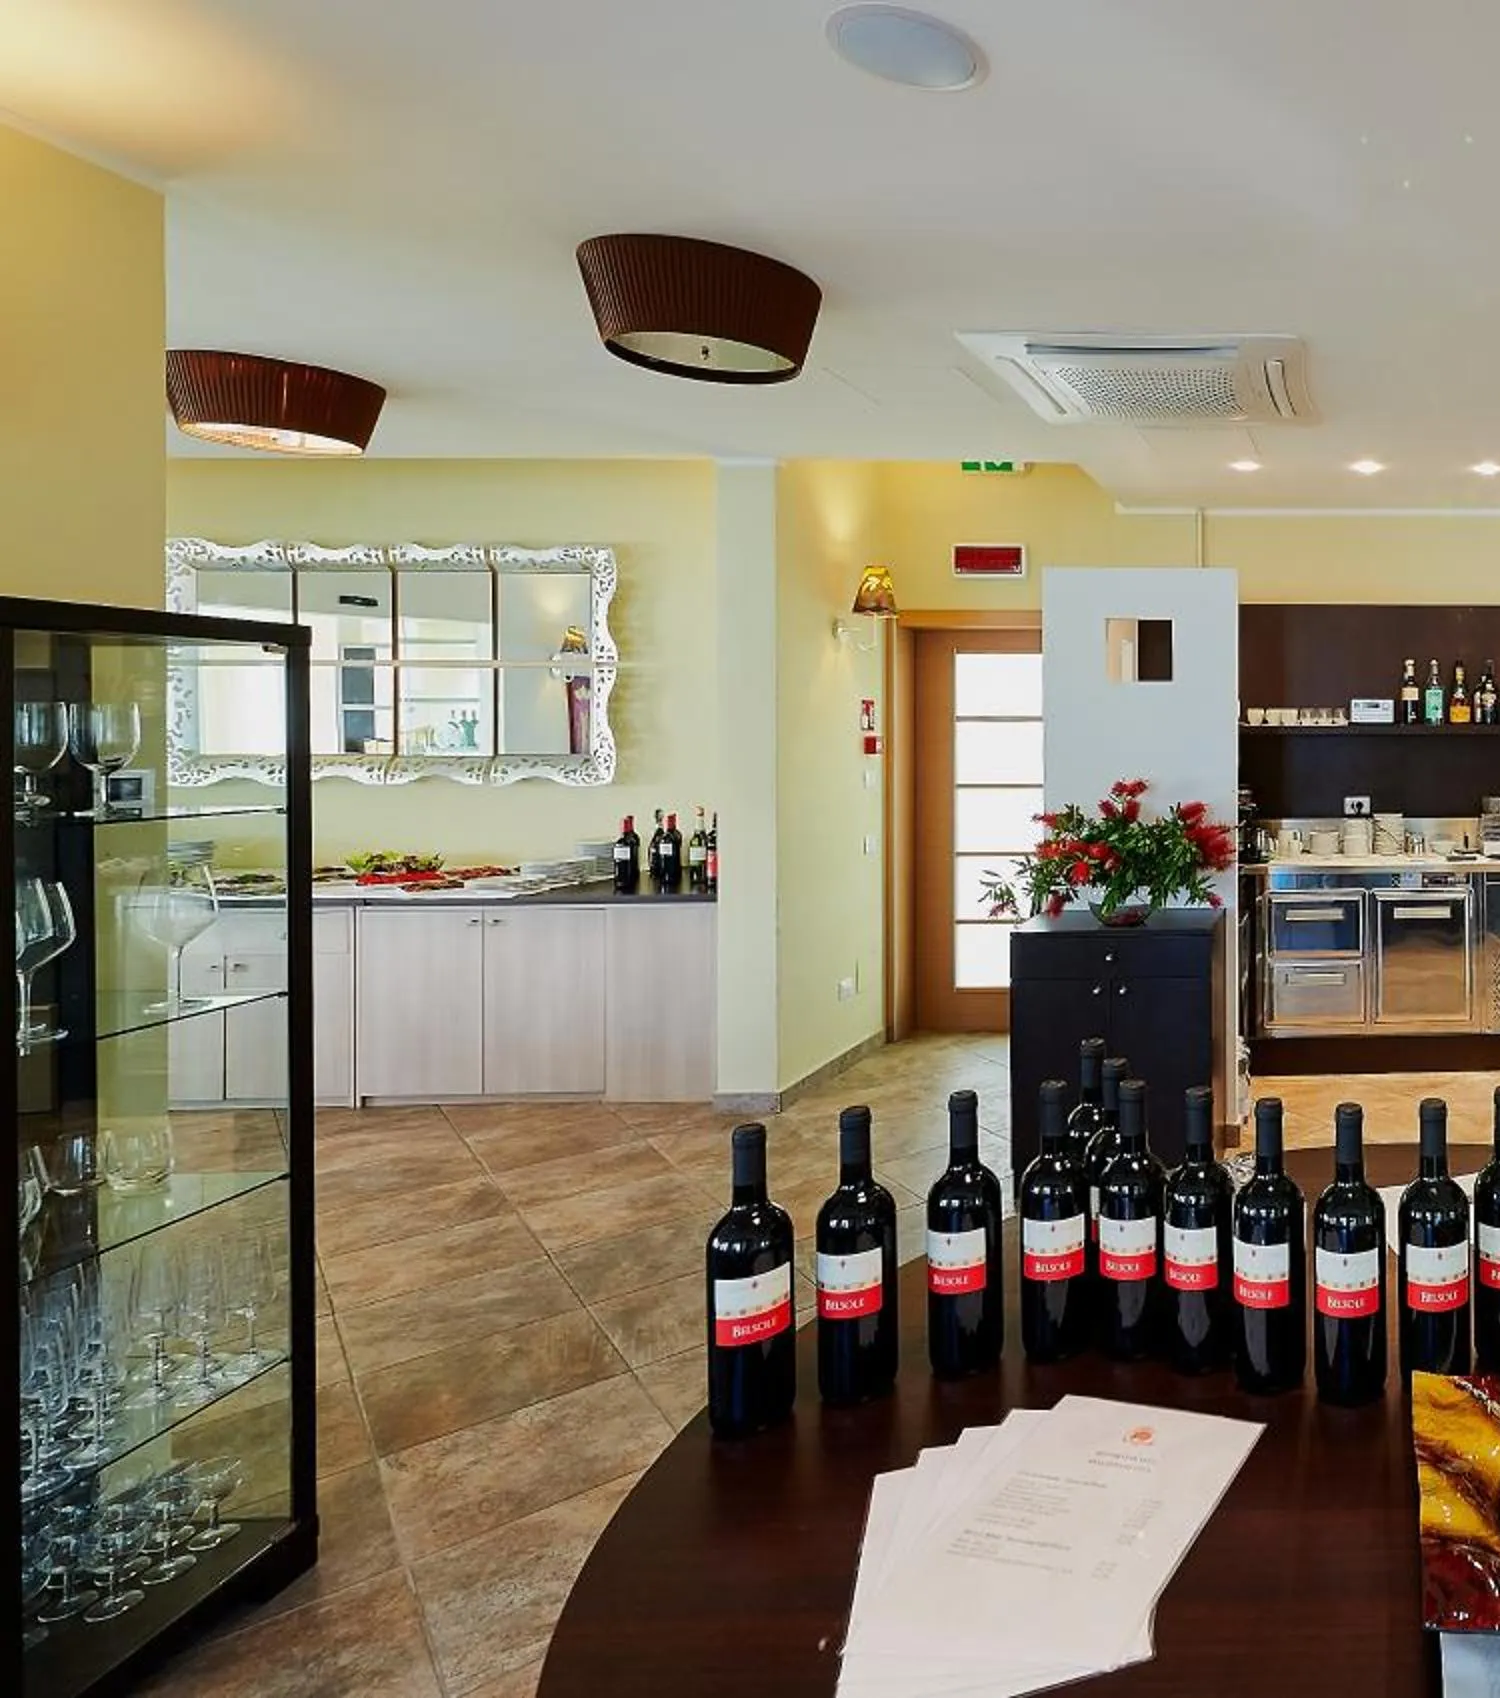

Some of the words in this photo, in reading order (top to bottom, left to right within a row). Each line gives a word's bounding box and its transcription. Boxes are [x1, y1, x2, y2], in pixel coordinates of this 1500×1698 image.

[1034, 1260, 1073, 1274] BELSOLE
[1105, 1259, 1141, 1273] BELSOLE
[932, 1274, 970, 1287] BELSOLE
[1239, 1284, 1273, 1299] BELSOLE
[1420, 1289, 1458, 1303] BELSOLE
[825, 1297, 865, 1311] BELSOLE
[1326, 1294, 1366, 1309] BELSOLE
[732, 1315, 778, 1338] BELSOLE
